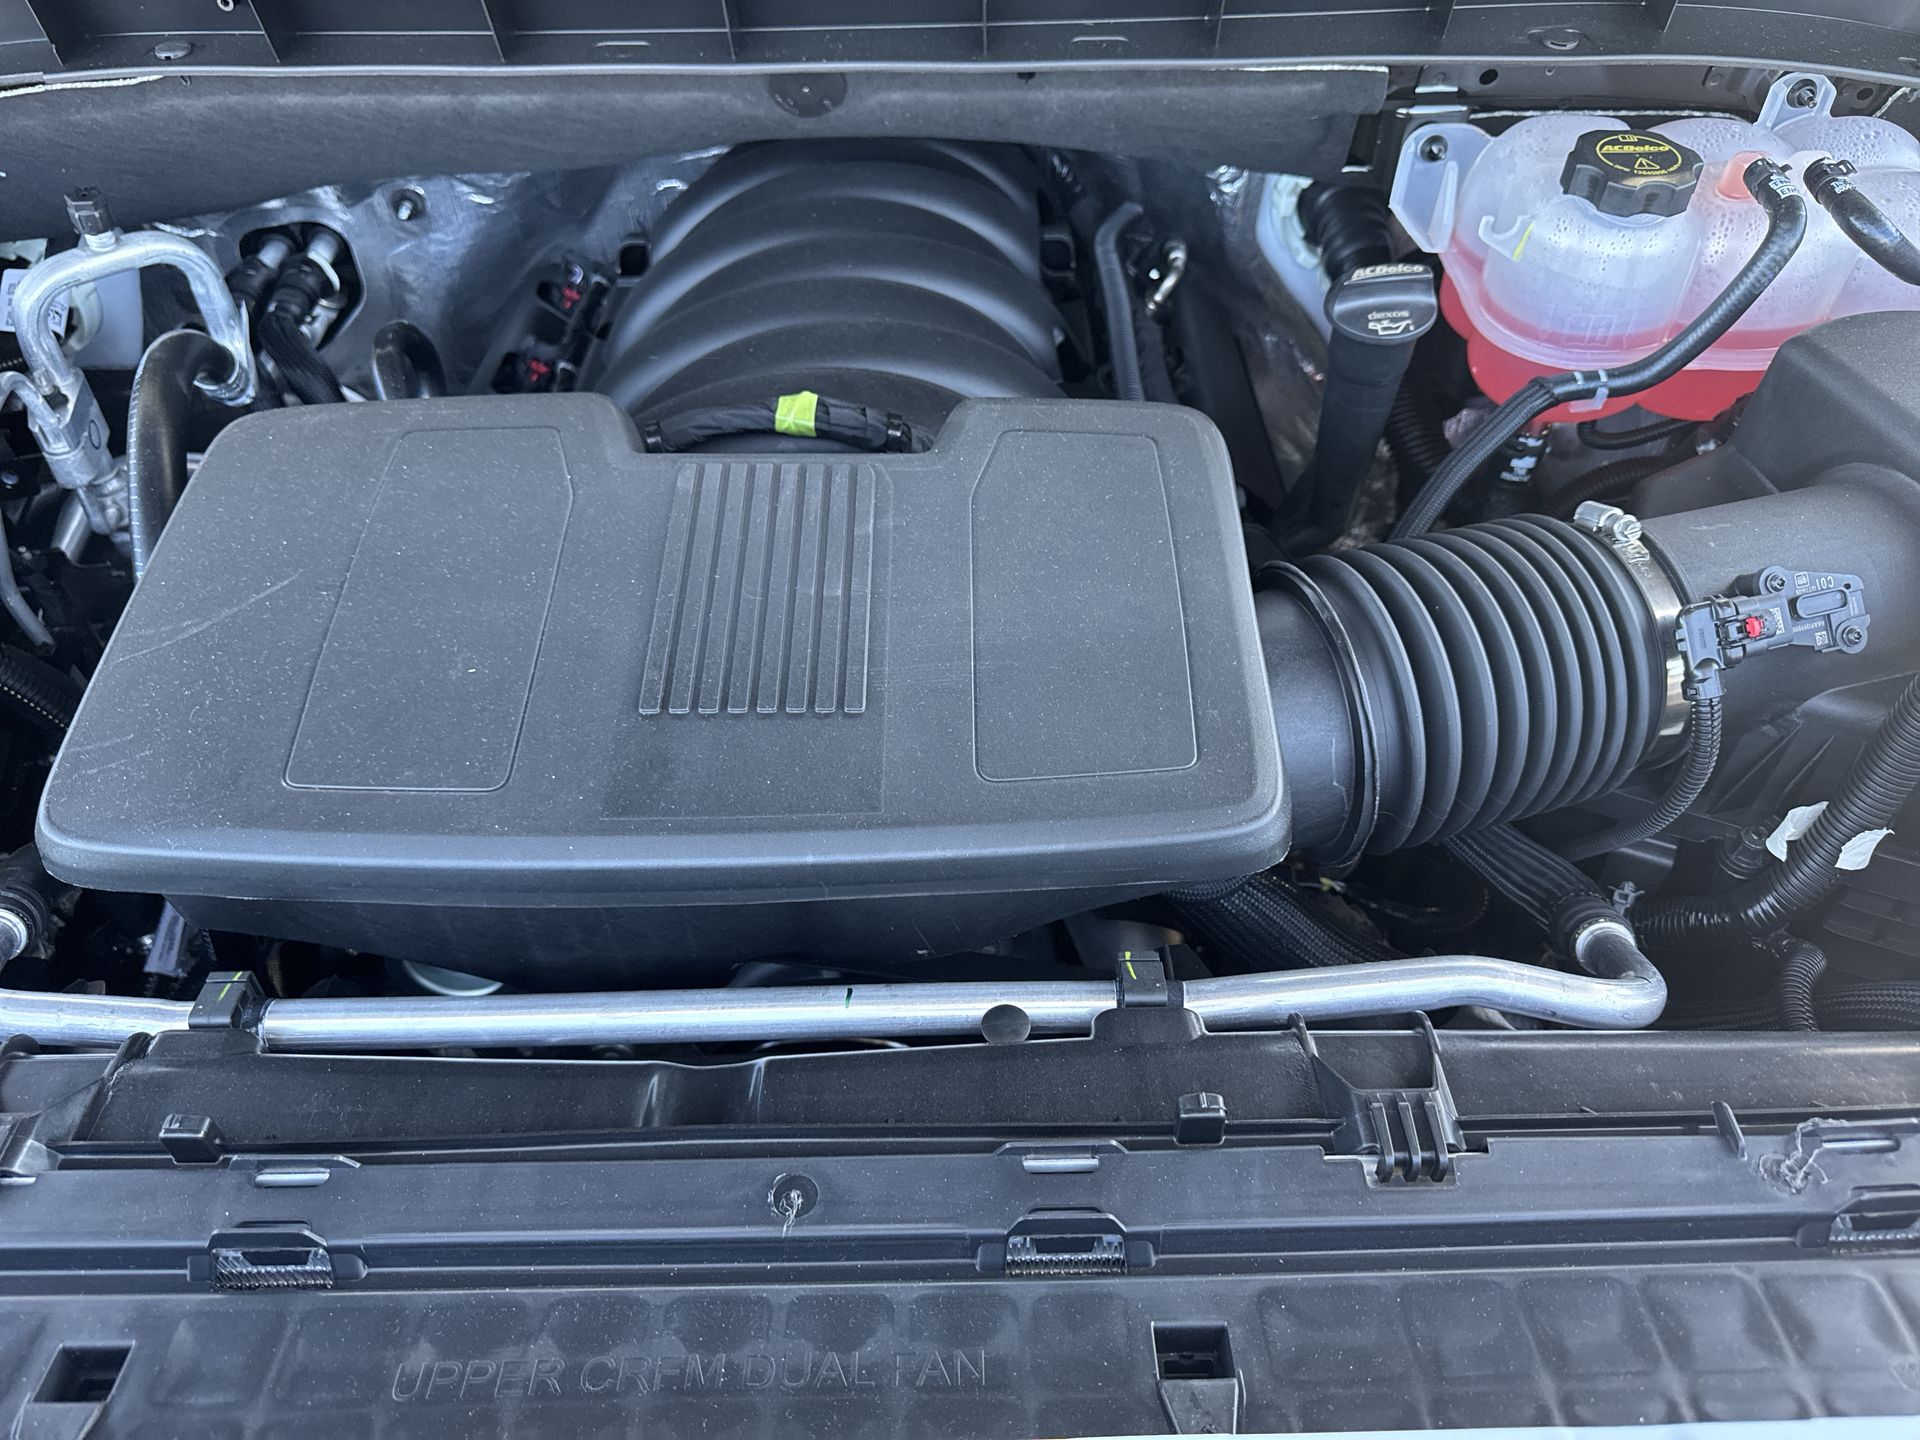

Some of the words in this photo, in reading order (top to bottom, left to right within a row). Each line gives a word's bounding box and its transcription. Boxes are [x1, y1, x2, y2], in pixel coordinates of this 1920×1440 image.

[1601, 144, 1670, 153] ACDelco
[1351, 263, 1425, 280] ACDelco
[1368, 311, 1410, 320] dexos
[392, 1358, 566, 1401] UPPER
[580, 1353, 727, 1394] CRFM
[741, 1351, 876, 1389] DUAL
[893, 1349, 987, 1387] FAN
